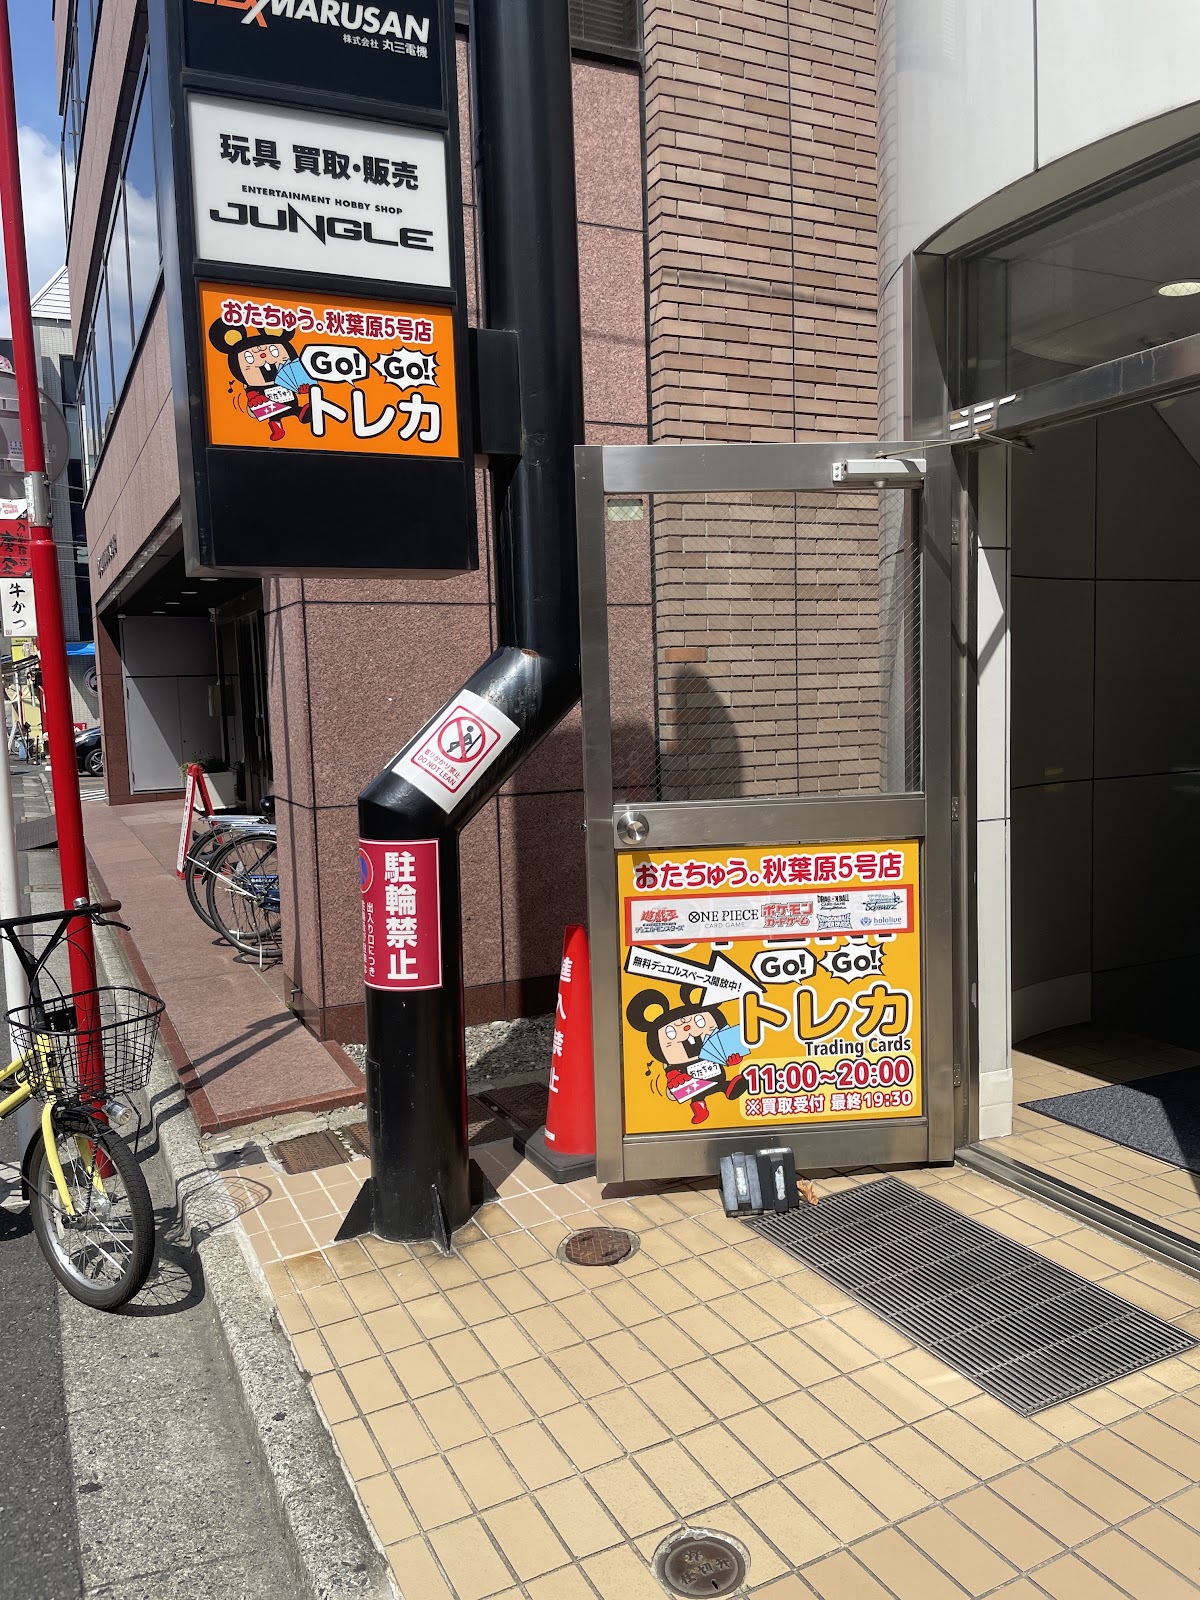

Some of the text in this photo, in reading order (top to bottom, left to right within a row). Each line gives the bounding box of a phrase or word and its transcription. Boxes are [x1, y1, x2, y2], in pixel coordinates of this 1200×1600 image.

[271, 0, 430, 44] MARUSAN
[342, 34, 429, 59] 株式会社 丸三電機
[219, 133, 419, 191] 玩具 買取・販売
[241, 184, 403, 215] ENTERTAINMENT HOBBY SHOP
[209, 202, 434, 251] JUNGLE
[222, 300, 433, 343] おたちゅう。秋葉原5号店
[310, 351, 431, 380] Go! Go!
[309, 385, 441, 442] トレカ
[9, 583, 27, 629] 牛かつ
[417, 754, 457, 786] DO NOT LEAN
[635, 852, 902, 889] おたちゅう。秋葉原5号店
[384, 850, 419, 980] 駐輪禁止
[688, 909, 759, 923] ONE PIECE
[761, 902, 814, 917] ポケモン
[763, 916, 811, 929] カードゲーム
[366, 901, 376, 977] 出入り口につき
[760, 949, 878, 978] Go! Go!
[743, 984, 910, 1045] トレカ
[804, 1036, 911, 1058] Trading Cards
